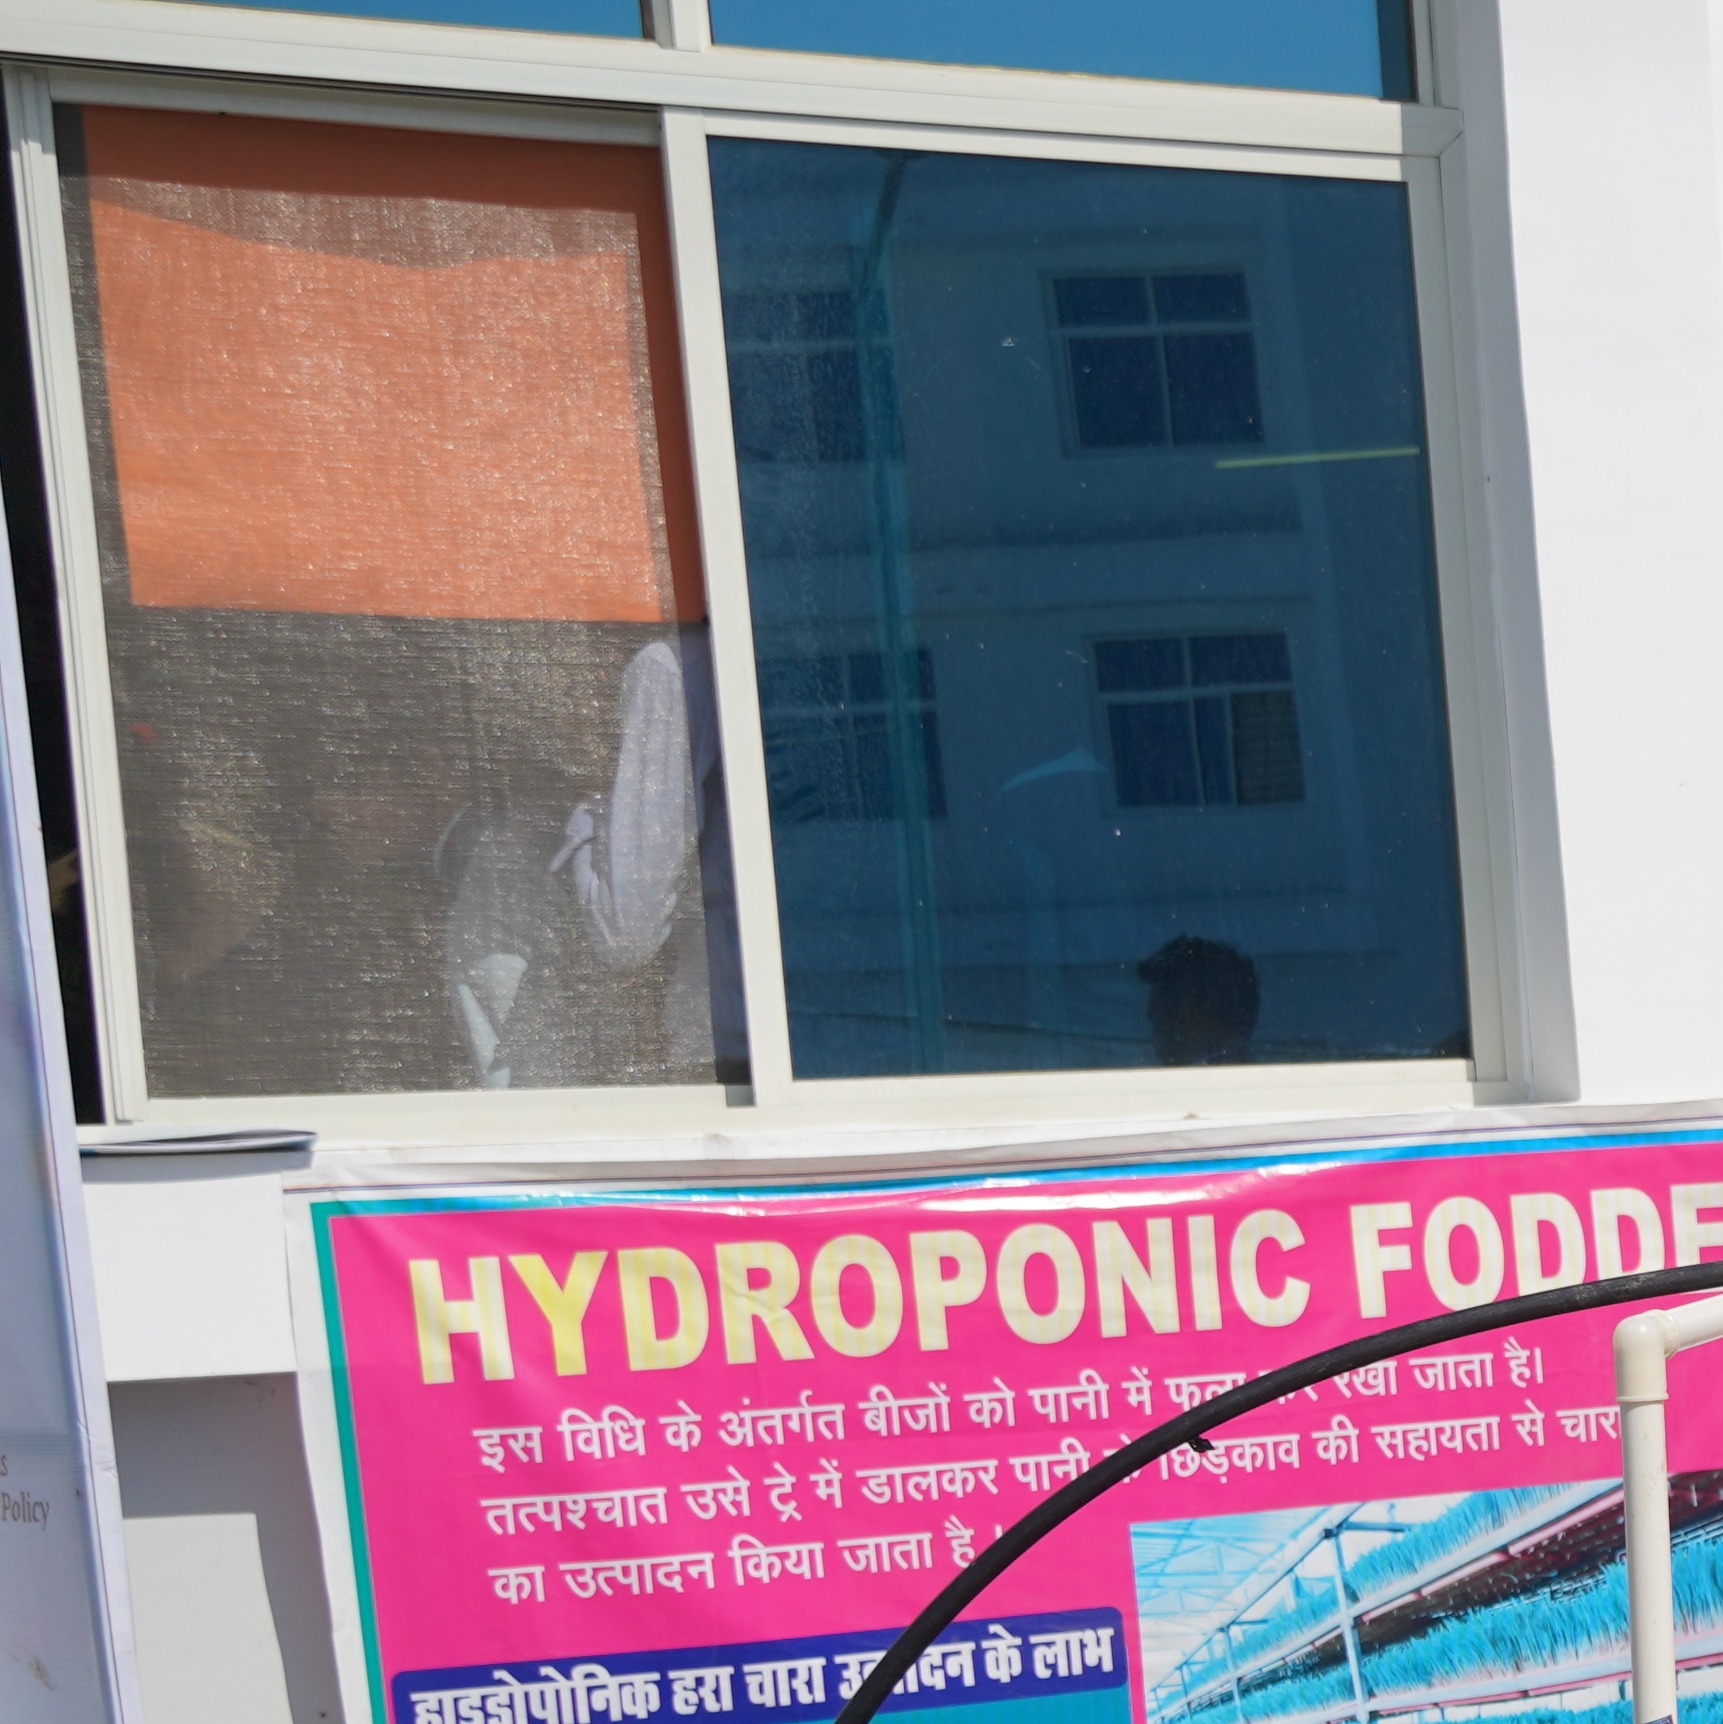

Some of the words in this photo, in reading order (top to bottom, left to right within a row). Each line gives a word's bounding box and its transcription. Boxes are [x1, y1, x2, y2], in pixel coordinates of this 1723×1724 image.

[408, 1209, 1311, 1385] HYDROPONIC
[473, 1425, 544, 1474] इस
[558, 1405, 645, 1461] विधि
[658, 1401, 702, 1452] के
[719, 1392, 846, 1448] अंतर्गत
[859, 1382, 951, 1438] बीजों
[964, 1377, 1017, 1430] को
[1028, 1368, 1111, 1424] पानी
[1121, 1366, 1153, 1416] में
[1409, 1345, 1496, 1393] जाता
[2, 1491, 51, 1532] Policy
[481, 1486, 668, 1535] तत्पश्चात
[681, 1467, 752, 1520] उसे
[764, 1463, 801, 1530] ट्रे
[812, 1458, 844, 1509] में
[857, 1454, 1001, 1505] डालकर
[1009, 1436, 1093, 1492] पानी
[1316, 1415, 1359, 1466] की
[1372, 1411, 1500, 1461] सहायता
[1512, 1403, 1548, 1449] से
[489, 1565, 546, 1605] का
[563, 1550, 718, 1598] उत्पादन
[728, 1532, 827, 1587] किया
[837, 1528, 935, 1575] जाता
[668, 1665, 735, 1716] हरा
[742, 1656, 827, 1708] चारा
[981, 1623, 1022, 1684] के
[1029, 1626, 1115, 1680] लाभ
